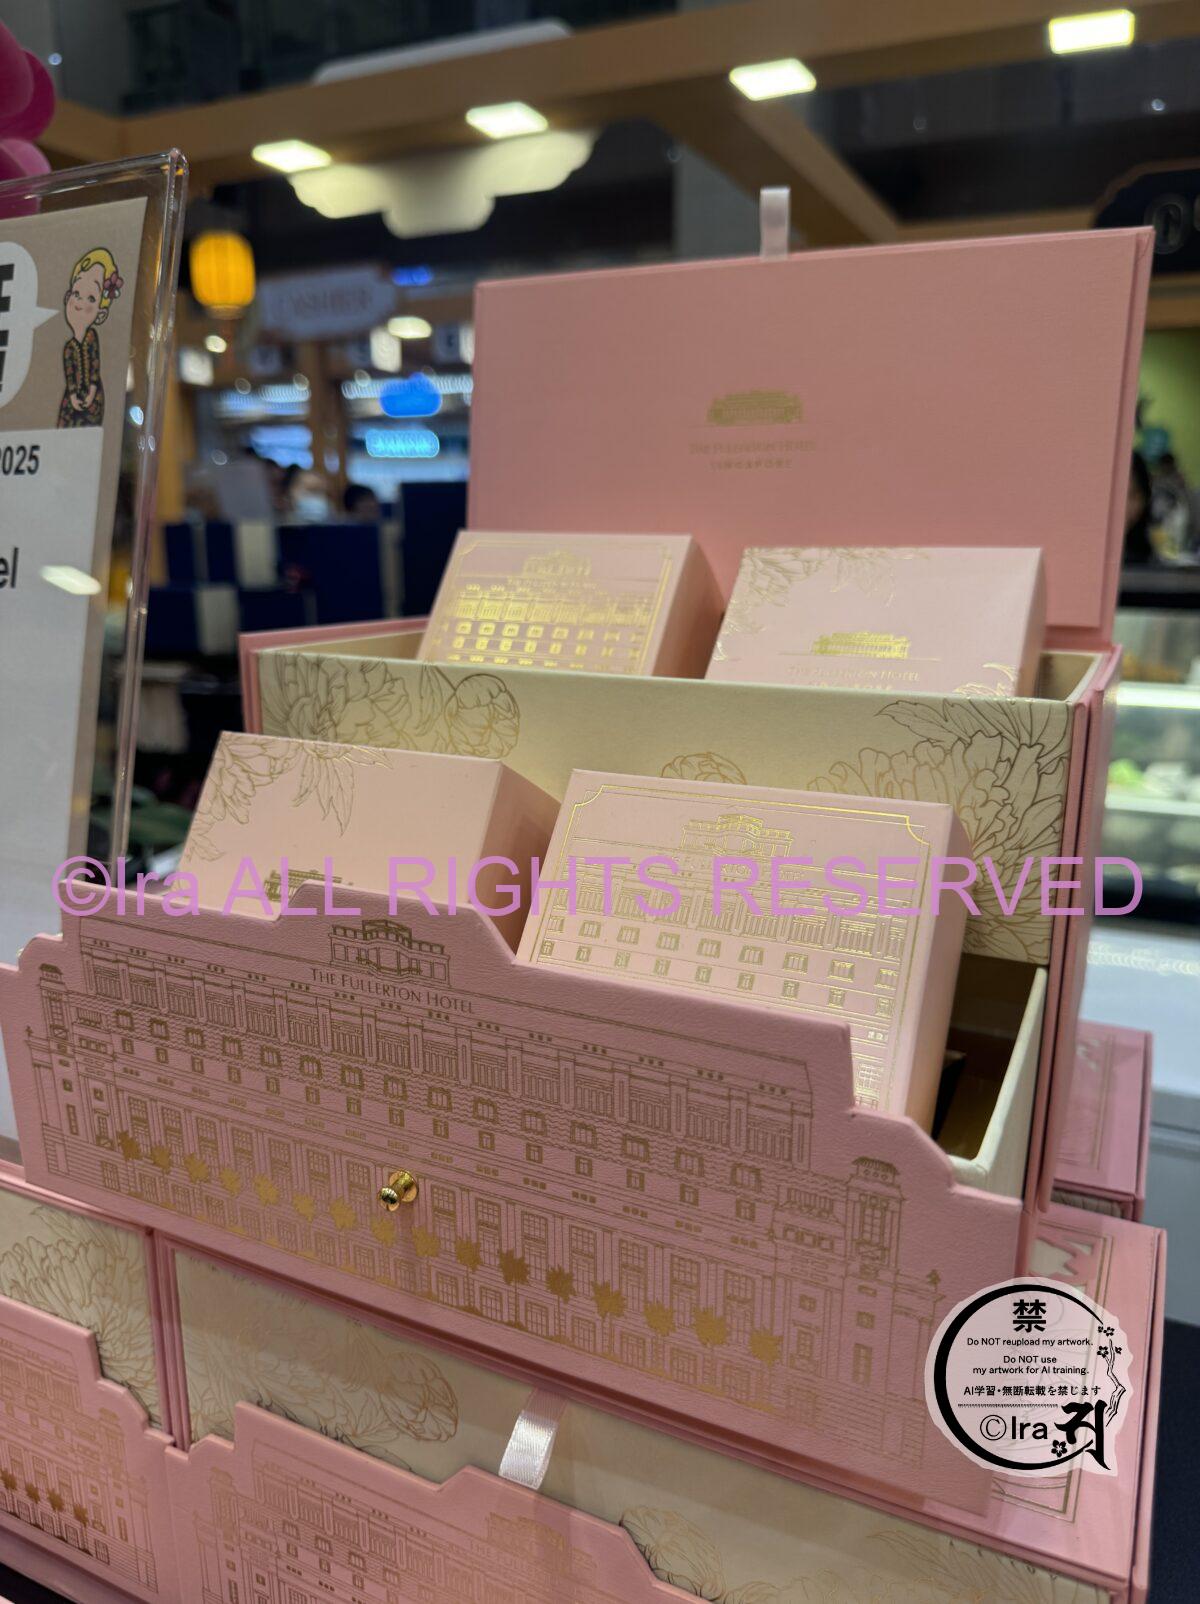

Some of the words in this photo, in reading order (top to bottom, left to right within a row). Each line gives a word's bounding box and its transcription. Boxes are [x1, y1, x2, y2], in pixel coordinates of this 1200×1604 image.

[0, 445, 40, 475] 025
[311, 968, 337, 985] THE
[341, 973, 421, 1003] FULLERTON
[427, 991, 473, 1014] HOTEL
